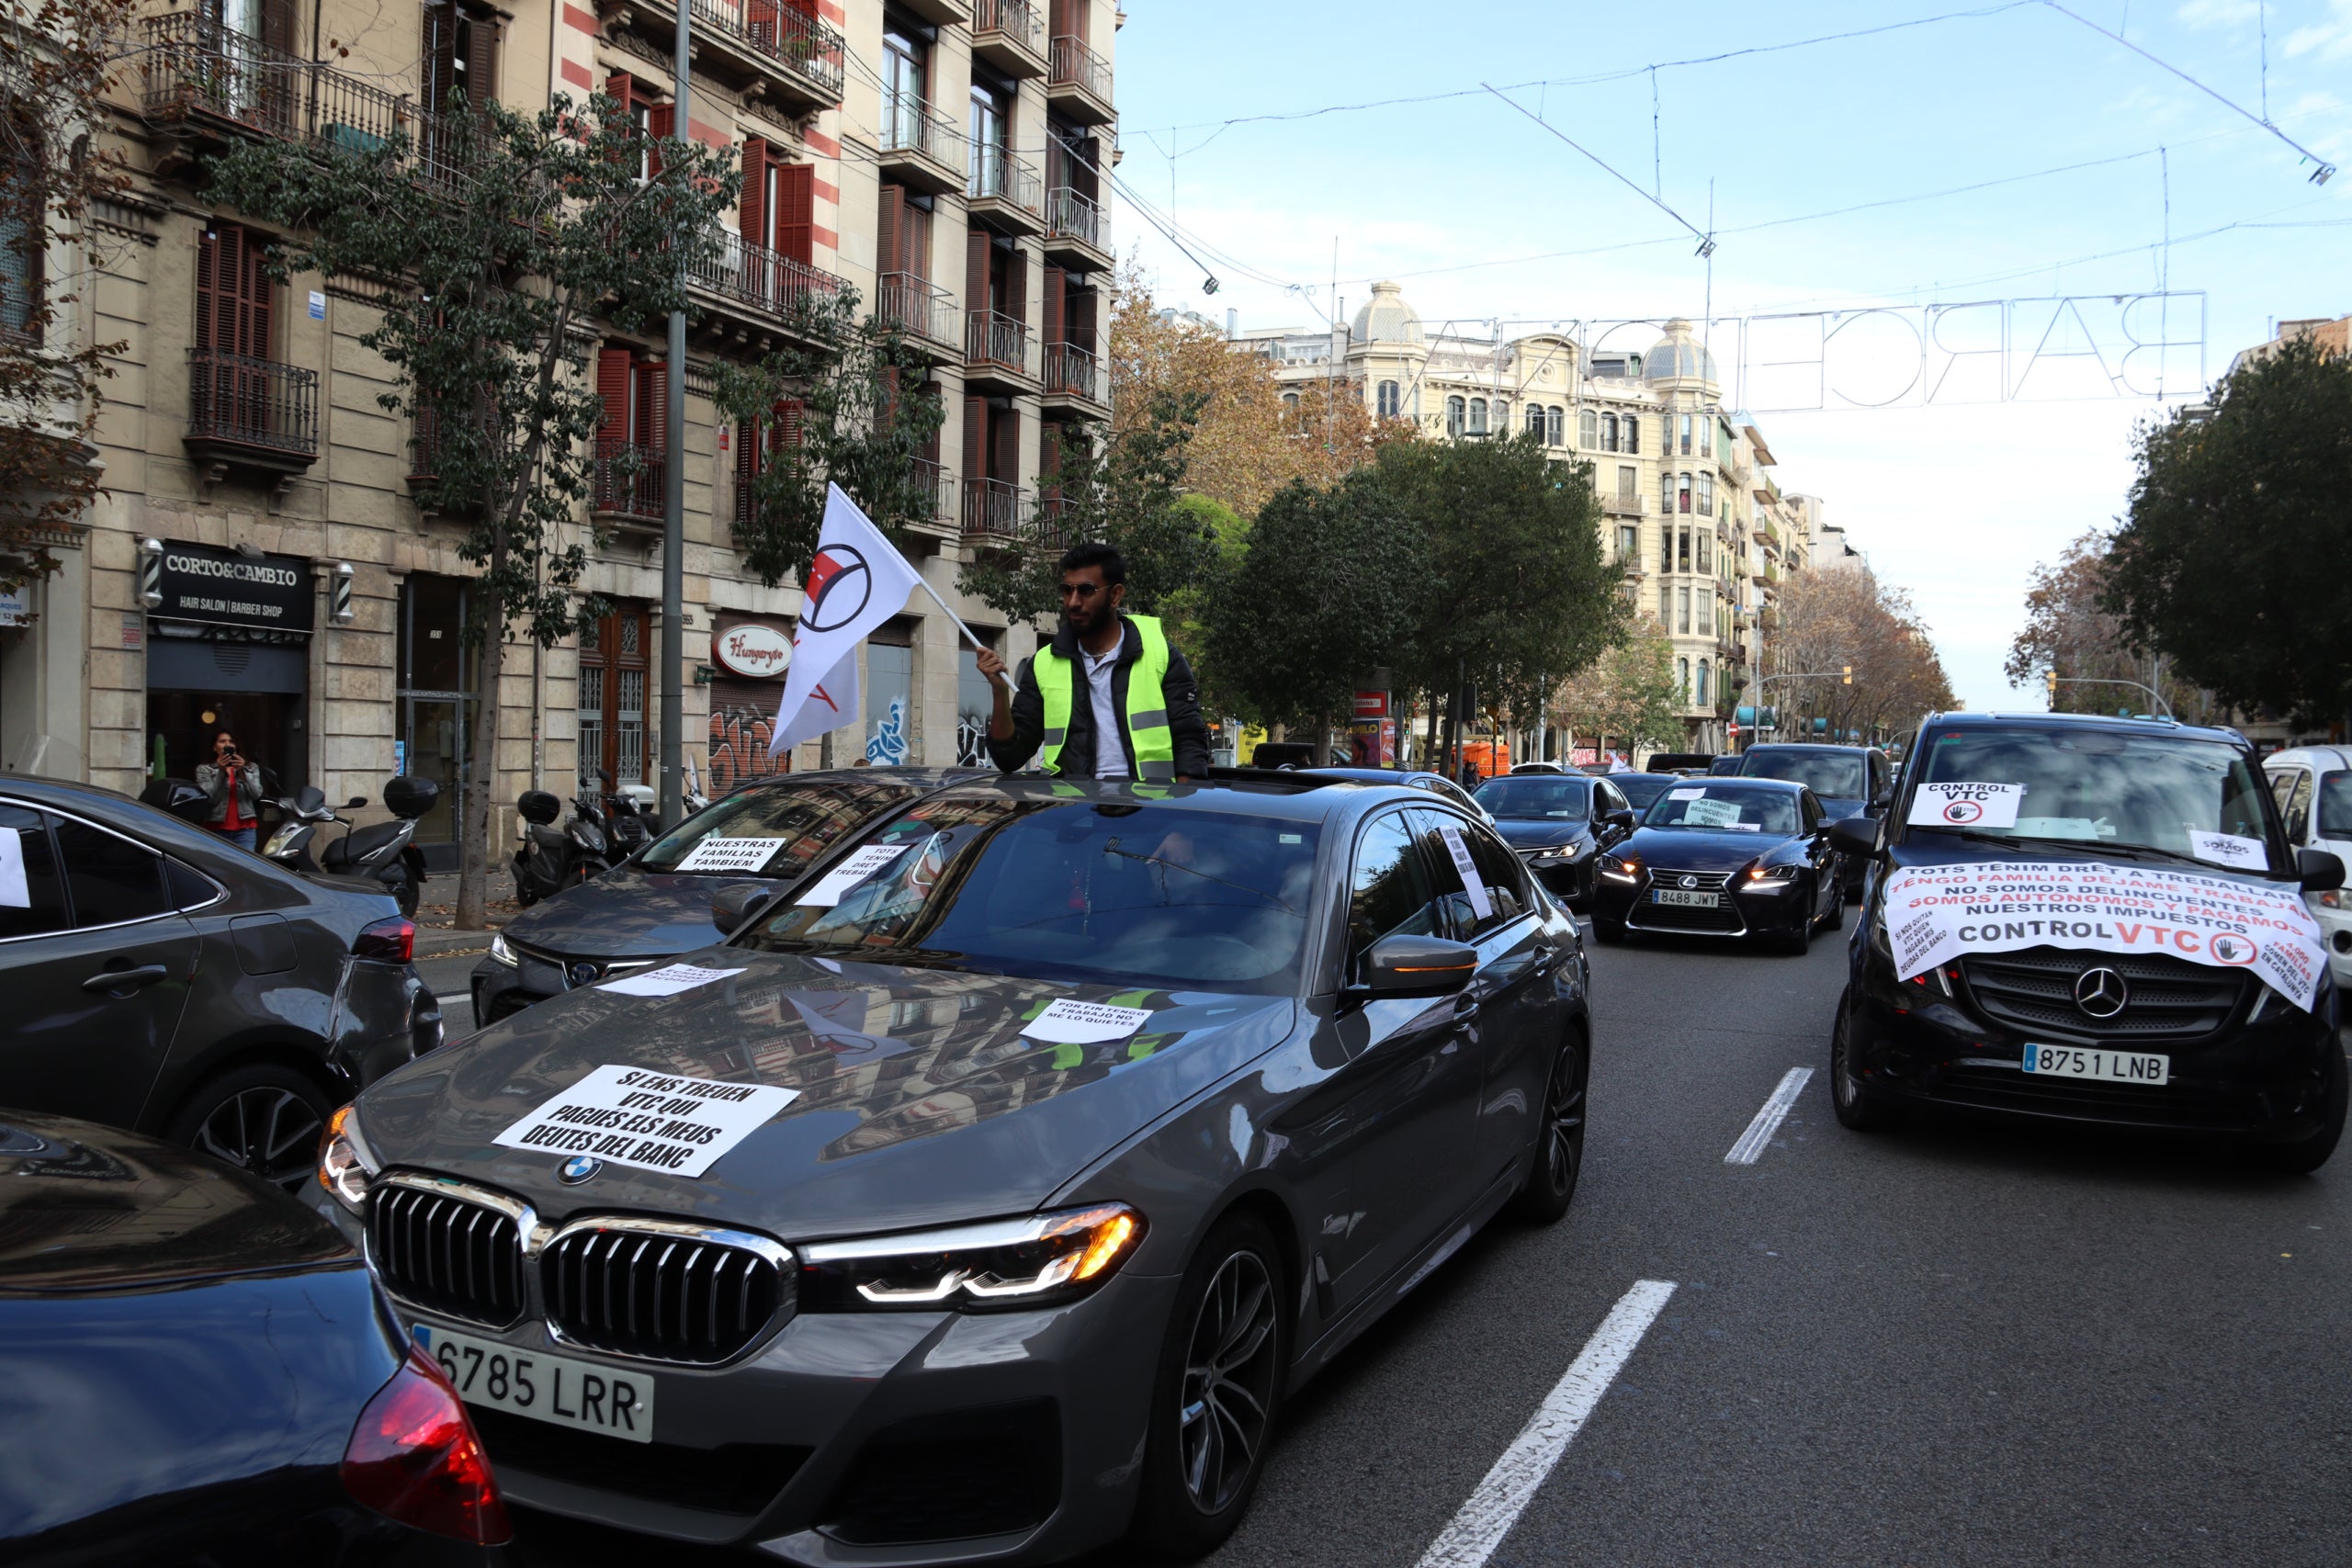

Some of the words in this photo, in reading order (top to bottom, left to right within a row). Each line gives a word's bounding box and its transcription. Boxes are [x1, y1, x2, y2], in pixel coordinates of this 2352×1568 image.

[166, 555, 297, 587] CORTO&CAMBIO
[179, 596, 198, 609] HAIR
[200, 598, 226, 613] SALON
[231, 603, 260, 616] BARBER
[262, 605, 283, 618] SHOP
[1928, 784, 2010, 793] CONTROL
[1945, 791, 1989, 801] VTC
[1690, 806, 1736, 820] DELINCUENTES
[1701, 815, 1722, 825] SOMOS
[1709, 802, 1731, 811] SOMOS
[2203, 840, 2249, 854] SOMOS
[1905, 866, 1965, 875] TOTS
[1973, 863, 2048, 873] TENIM
[2058, 864, 2120, 875] DRET
[2129, 870, 2145, 878] A
[2153, 872, 2296, 901] TREBALLAR
[1661, 891, 1691, 904] 8488
[1694, 894, 1717, 906] JWY
[1890, 875, 1968, 894] TENGO
[1977, 874, 2074, 883] FAMILIA
[2082, 875, 2181, 893] DEJAME
[2188, 886, 2312, 922] TRABAJAR
[1944, 886, 1977, 896] NO
[1985, 885, 2069, 894] SOMOS
[2078, 886, 2264, 916] DELINCUENTES
[1894, 931, 1902, 942] SI
[1901, 923, 1913, 935] NOS
[1912, 909, 1933, 926] QUITAN
[1908, 894, 1992, 908] SOMOS
[1999, 891, 2155, 908] AUTÓNOMOS
[2163, 901, 2177, 911] Y
[2187, 905, 2305, 936] PAGAMOS
[1966, 903, 2098, 915] NUESTROS
[2105, 906, 2248, 934] IMPUESTOS
[1903, 932, 1914, 945] VTC
[1914, 920, 1930, 937] QUIEN
[1924, 927, 1935, 939] MIS
[1900, 952, 1920, 974] DEUDAS
[1918, 944, 1930, 956] DEL
[1928, 930, 1947, 948] BANCO
[2273, 942, 2312, 980] FAMILIAS
[2287, 942, 2309, 964] 4.000
[2261, 952, 2272, 964] EN
[2270, 962, 2303, 1001] CATALUNYA
[2265, 944, 2288, 967] COMEN
[2287, 965, 2299, 981] DEL
[2298, 977, 2311, 994] VTC
[1061, 1008, 1114, 1019] TRABAJO
[1084, 1017, 1136, 1027] QUIETES
[1107, 1007, 1146, 1016] TENGO
[2040, 1049, 2102, 1075] 8751
[2113, 1055, 2162, 1079] LNB
[616, 1071, 650, 1087] SI
[643, 1075, 680, 1093] ENS
[679, 1081, 758, 1102] TREUEN
[616, 1091, 662, 1111] VTC
[659, 1099, 704, 1117] QUI
[547, 1104, 629, 1129] PAGUÉS
[622, 1114, 664, 1135] ELS
[656, 1120, 723, 1145] MEUS
[520, 1123, 602, 1152] DEUTES
[591, 1135, 638, 1158] DEL
[628, 1140, 695, 1169] BANC
[437, 1341, 535, 1407] 6785
[552, 1367, 635, 1431] LRR
